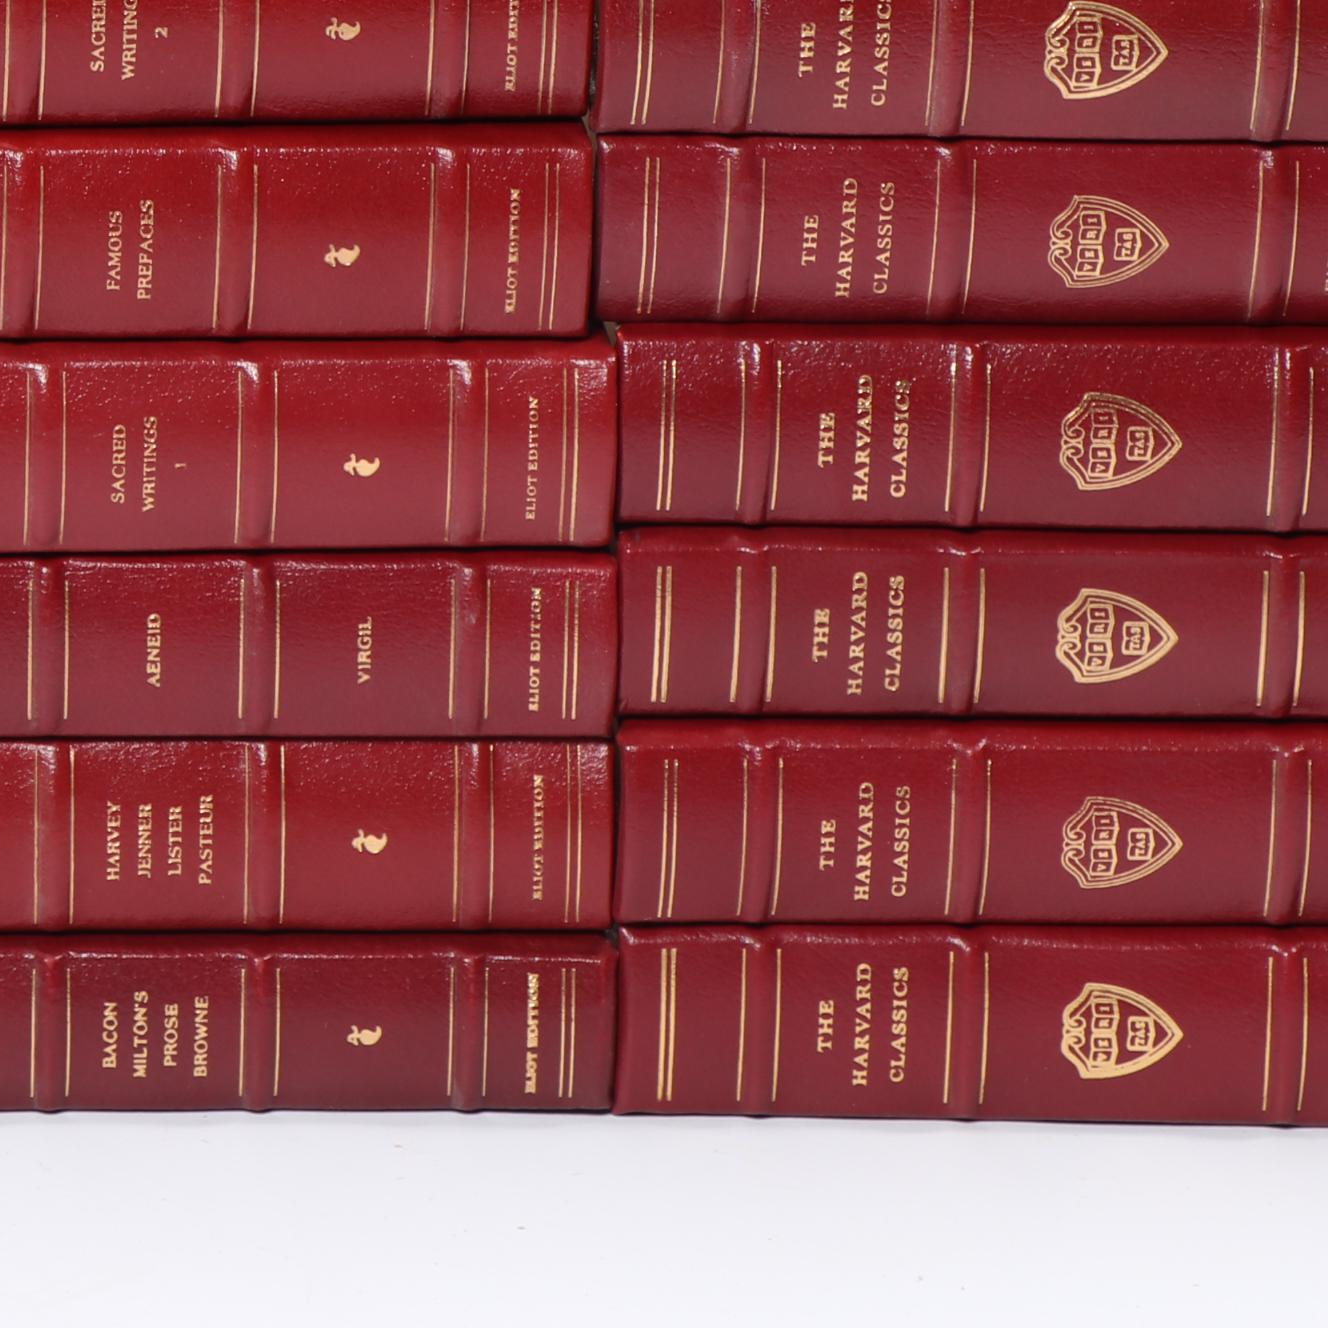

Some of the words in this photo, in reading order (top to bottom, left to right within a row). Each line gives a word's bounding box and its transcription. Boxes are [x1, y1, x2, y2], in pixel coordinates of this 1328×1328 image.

[155, 26, 168, 38] 2
[798, 22, 816, 77] THE
[107, 210, 123, 291] FAMOUS
[138, 199, 155, 300] PREFACES
[801, 214, 819, 266] THE
[835, 177, 858, 298] HARVARD
[874, 181, 895, 294] CLASSICS
[111, 424, 127, 504] SACRED
[142, 416, 158, 512] WRITINGS
[527, 396, 540, 471] EDITION
[817, 412, 835, 468] THE
[852, 374, 873, 501] HARVARD
[890, 379, 911, 498] CLASSICS
[526, 474, 538, 520] ELIOT
[146, 613, 162, 687] AENEID
[357, 617, 373, 684] VIRGIL
[813, 608, 830, 663] THE
[847, 571, 868, 696] HARVARD
[885, 575, 905, 692] CLASSICS
[106, 800, 122, 881] HARVEY
[137, 803, 152, 878] JENNER
[167, 806, 183, 876] LISTER
[198, 794, 214, 884] PASTEUR
[820, 819, 836, 871] THE
[854, 781, 874, 901] HARVARD
[892, 786, 911, 898] CLASSICS
[102, 1002, 118, 1069] BACON
[133, 990, 149, 1078] MILTON'S
[164, 1003, 179, 1067] PROSE
[194, 996, 209, 1078] BROWNE
[816, 999, 834, 1052] THE
[852, 962, 872, 1086] HARVARD
[889, 966, 909, 1083] CLASSICS
